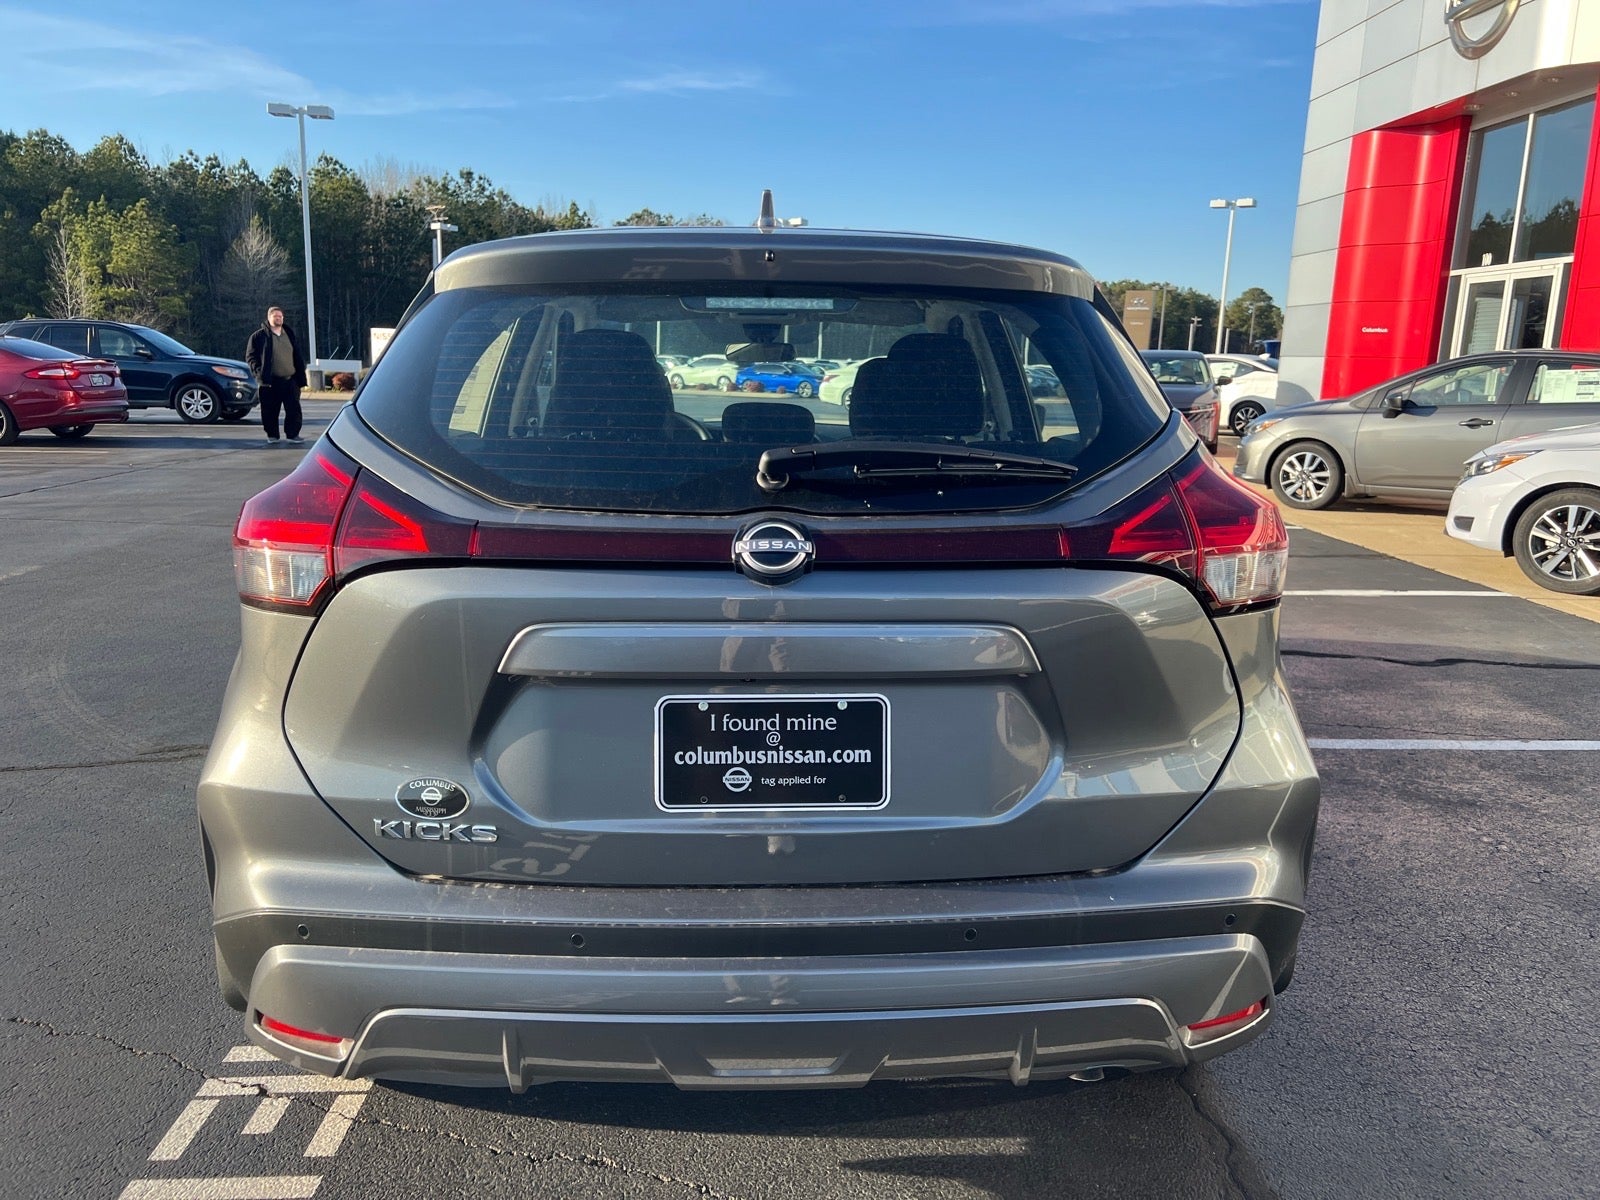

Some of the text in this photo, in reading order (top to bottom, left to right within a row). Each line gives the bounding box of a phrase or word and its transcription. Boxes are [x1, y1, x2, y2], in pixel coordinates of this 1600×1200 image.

[738, 540, 810, 551] NISSAN
[710, 713, 837, 732] I found mine
[766, 731, 781, 747] @
[674, 745, 872, 765] columbusnissan.com
[409, 779, 456, 792] COLUMBUS
[761, 775, 827, 787] tag applied for
[373, 818, 498, 842] KICKS
